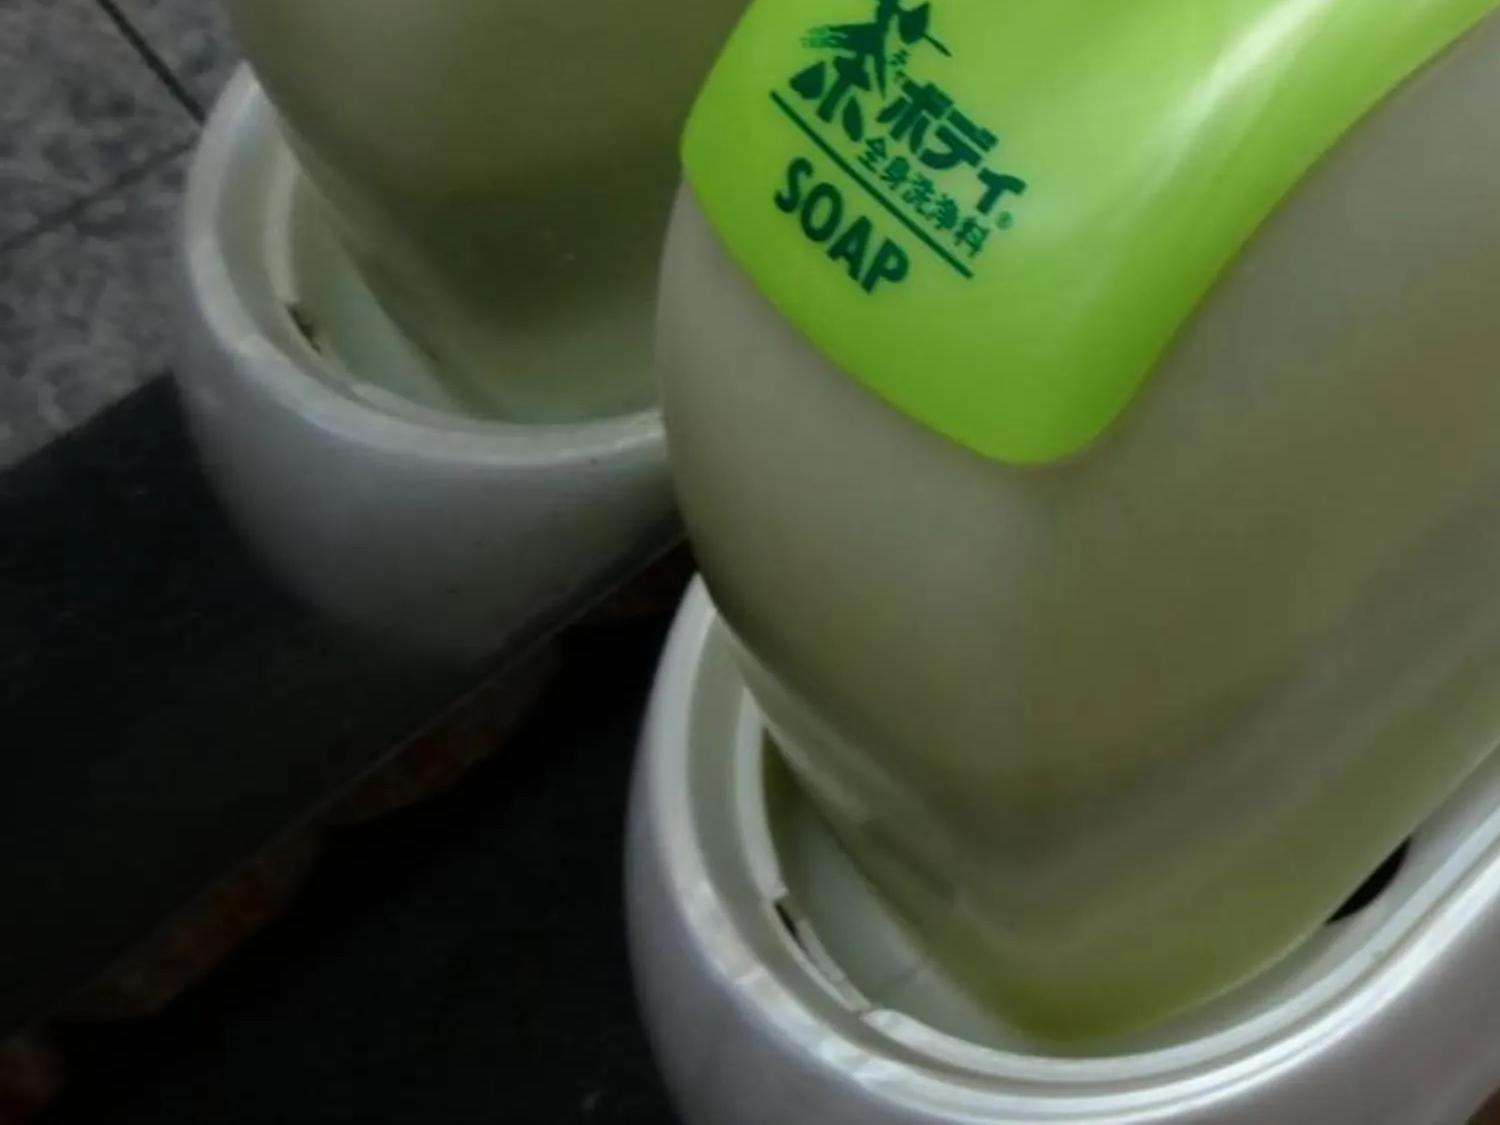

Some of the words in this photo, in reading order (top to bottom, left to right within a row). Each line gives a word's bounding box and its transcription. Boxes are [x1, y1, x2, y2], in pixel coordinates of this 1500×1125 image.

[773, 156, 910, 294] SOAP
[856, 136, 991, 258] 全身洗浄料
